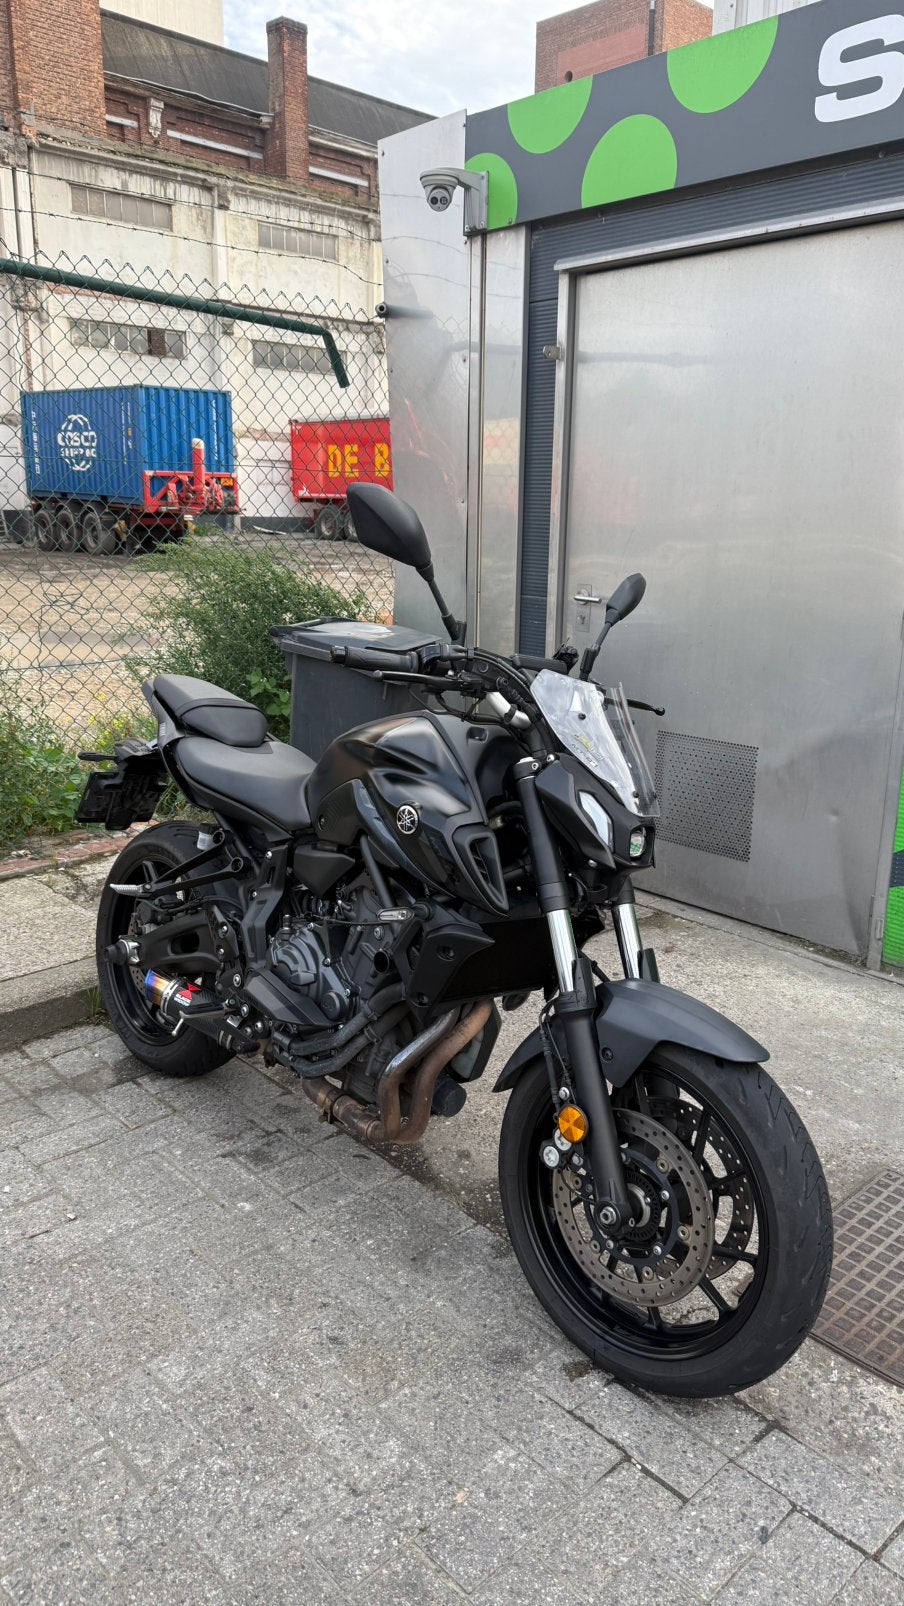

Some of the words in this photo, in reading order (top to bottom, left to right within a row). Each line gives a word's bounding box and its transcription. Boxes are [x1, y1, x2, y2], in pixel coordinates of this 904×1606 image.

[815, 14, 904, 122] S
[57, 431, 97, 447] COSCO
[328, 444, 359, 477] DE
[375, 443, 390, 477] B
